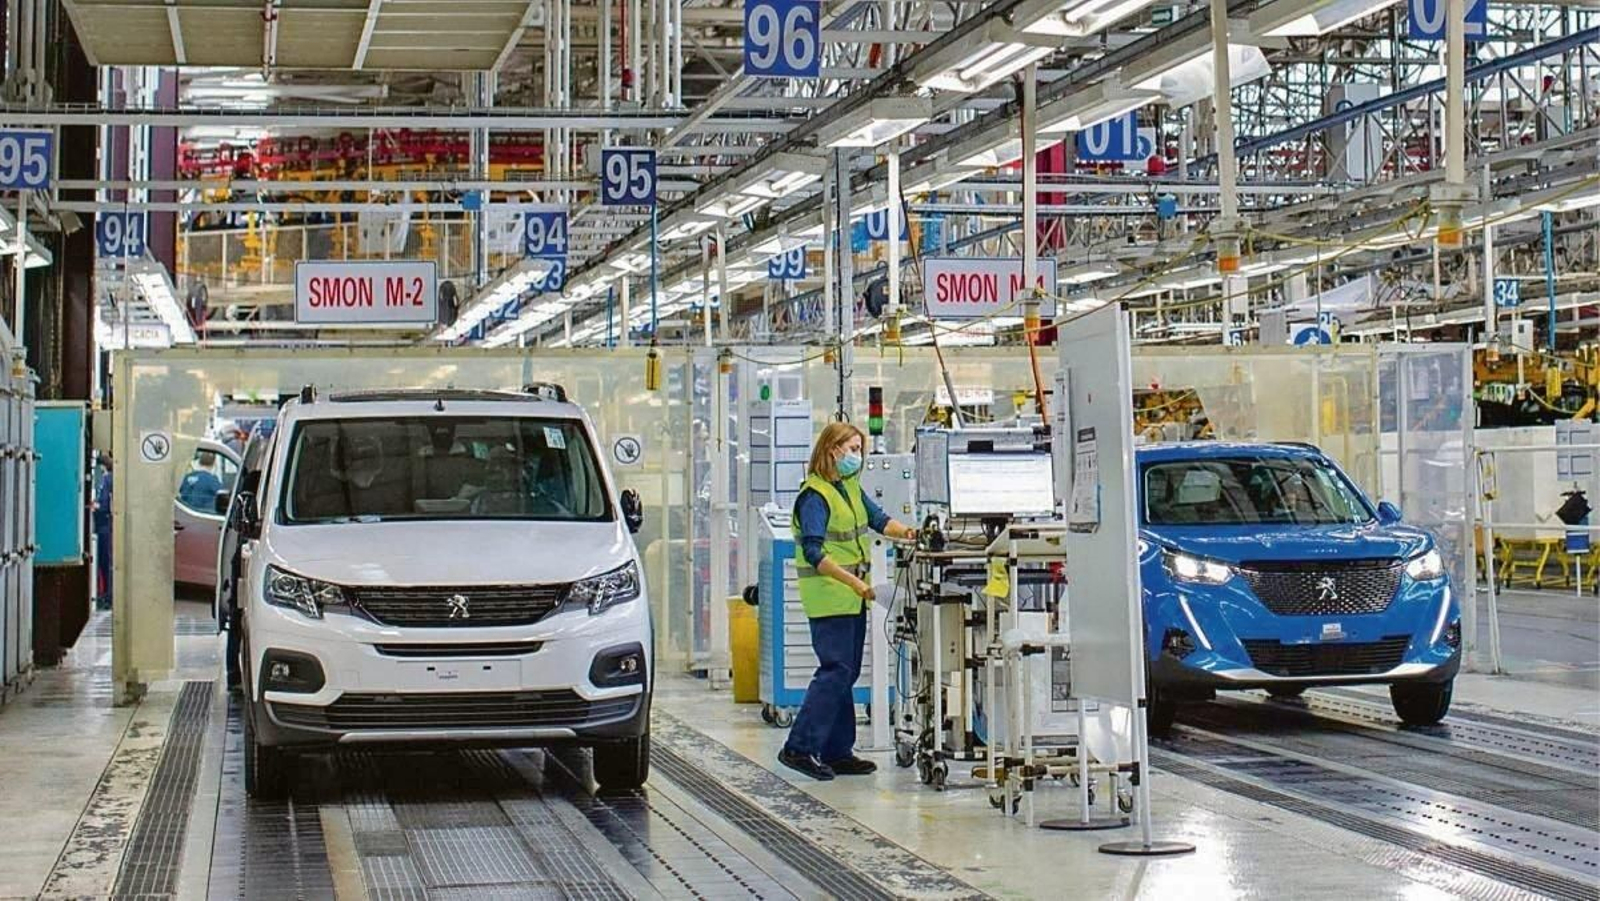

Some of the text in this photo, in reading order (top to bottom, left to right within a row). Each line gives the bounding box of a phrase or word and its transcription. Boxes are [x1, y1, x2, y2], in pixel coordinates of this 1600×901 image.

[748, 4, 815, 70] 96
[1085, 113, 1132, 156] 01
[0, 137, 48, 186] 95
[606, 153, 652, 199] 95
[104, 215, 140, 253] 94
[527, 216, 566, 253] 94
[771, 249, 804, 277] 99
[309, 276, 424, 307] SMON M-2
[936, 273, 998, 303] SMON
[1496, 280, 1518, 306] 34
